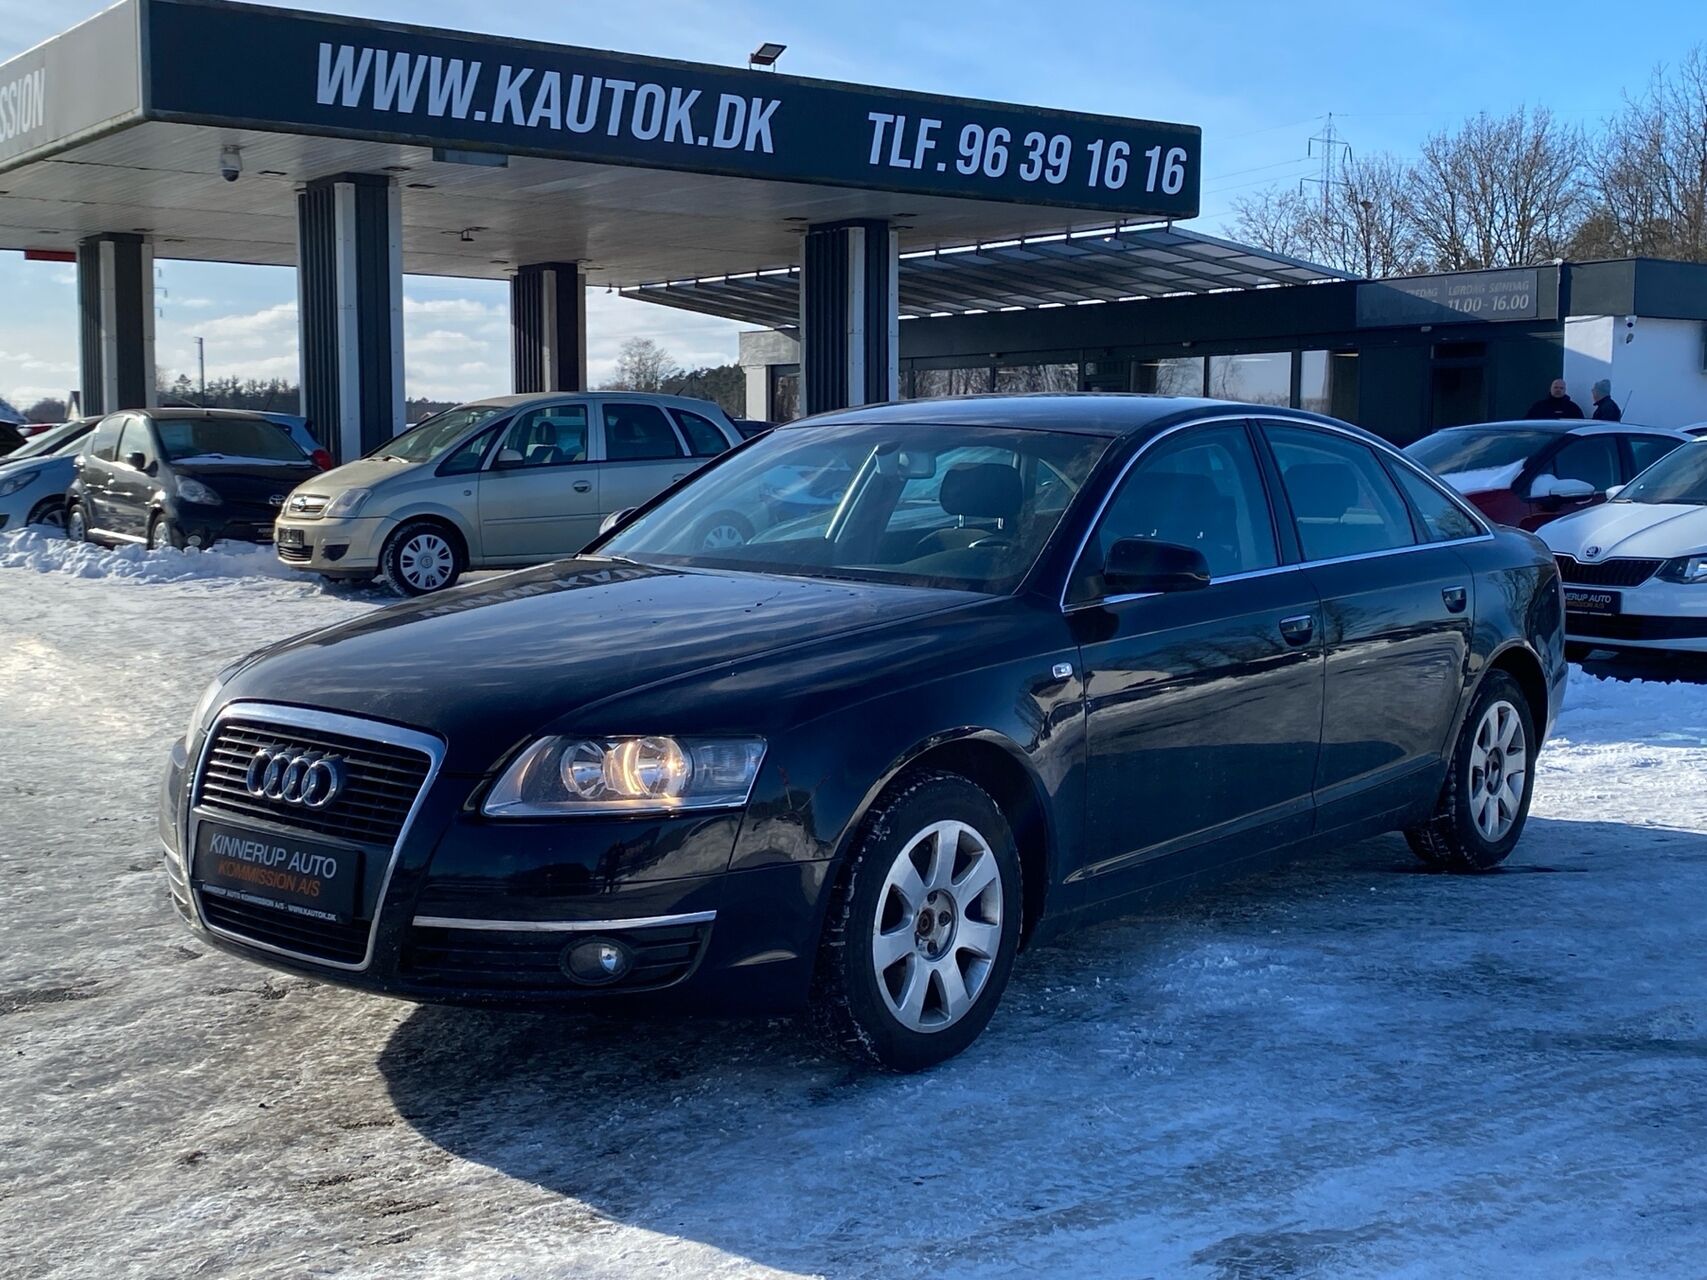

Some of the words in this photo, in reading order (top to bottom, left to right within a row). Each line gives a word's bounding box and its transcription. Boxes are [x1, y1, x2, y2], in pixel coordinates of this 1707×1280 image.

[317, 42, 781, 154] WWW.KAUTOK.DK
[868, 111, 945, 172] TLF.
[957, 123, 1011, 178] 96
[1020, 131, 1072, 184] 39
[1087, 138, 1130, 190] 16
[1145, 145, 1188, 196] 16
[1491, 294, 1529, 312] 16.00
[1588, 594, 1612, 604] AUTO
[209, 833, 286, 868] KINNERUP
[288, 851, 337, 879] AUTO
[218, 859, 295, 891] KOMMISSION
[298, 878, 321, 897] A/S
